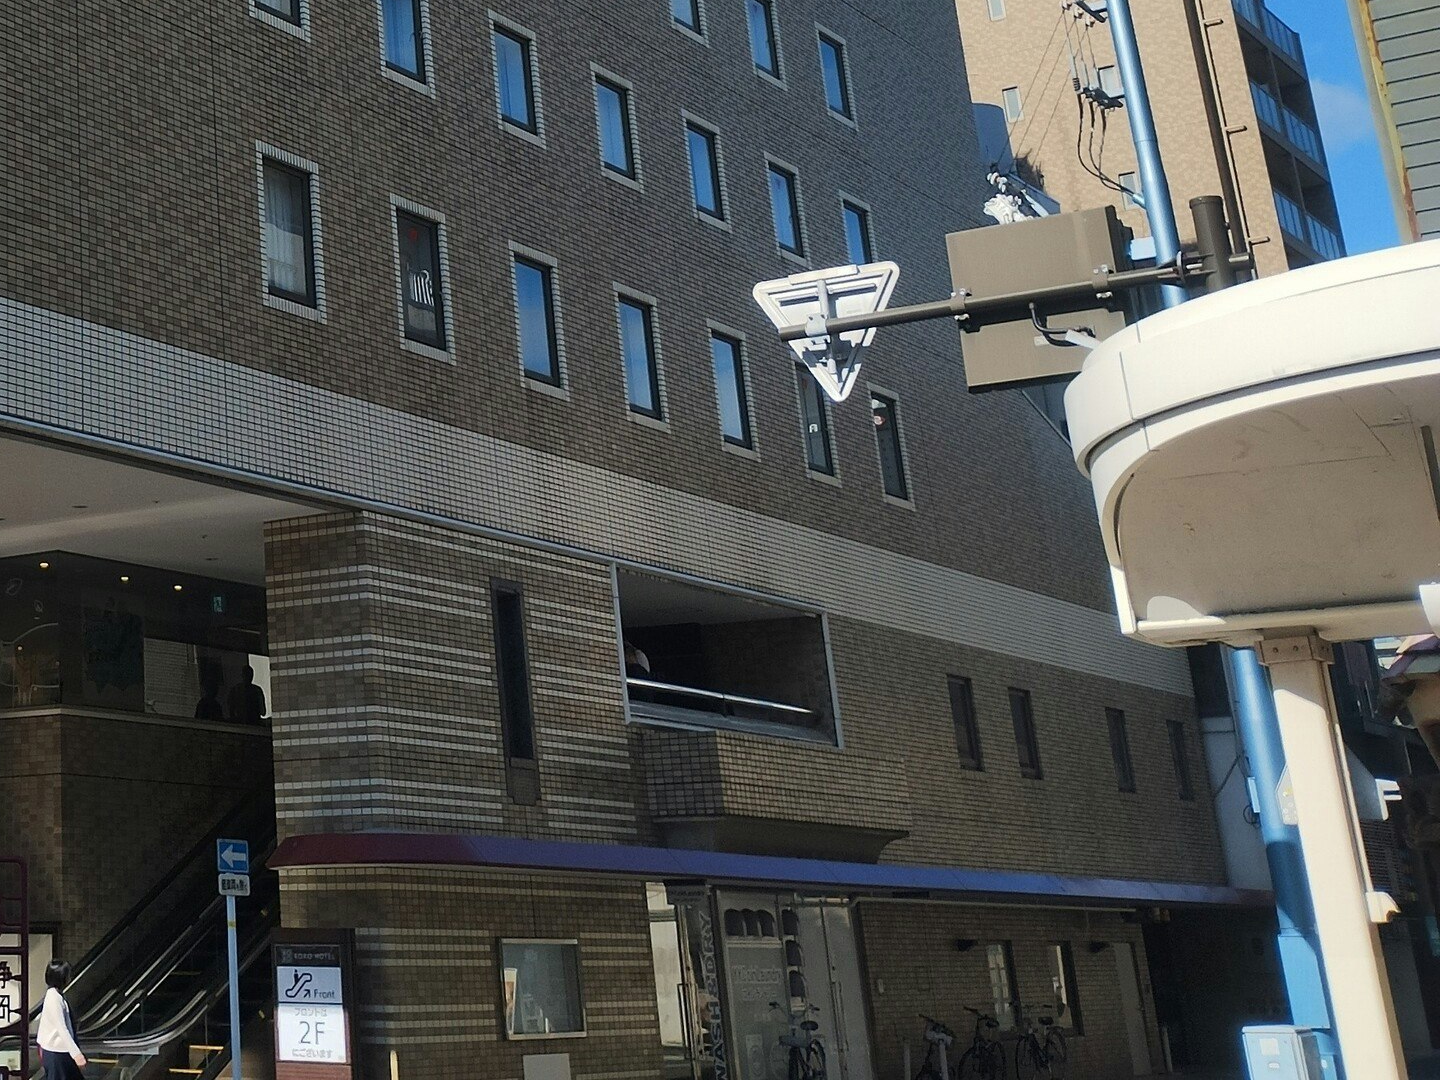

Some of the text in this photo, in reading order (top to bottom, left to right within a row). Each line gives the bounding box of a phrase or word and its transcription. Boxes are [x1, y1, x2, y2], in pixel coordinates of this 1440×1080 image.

[314, 988, 335, 999] Front
[294, 1007, 328, 1017] フロントは
[299, 1020, 325, 1045] 2F
[292, 1048, 333, 1059] にございます
